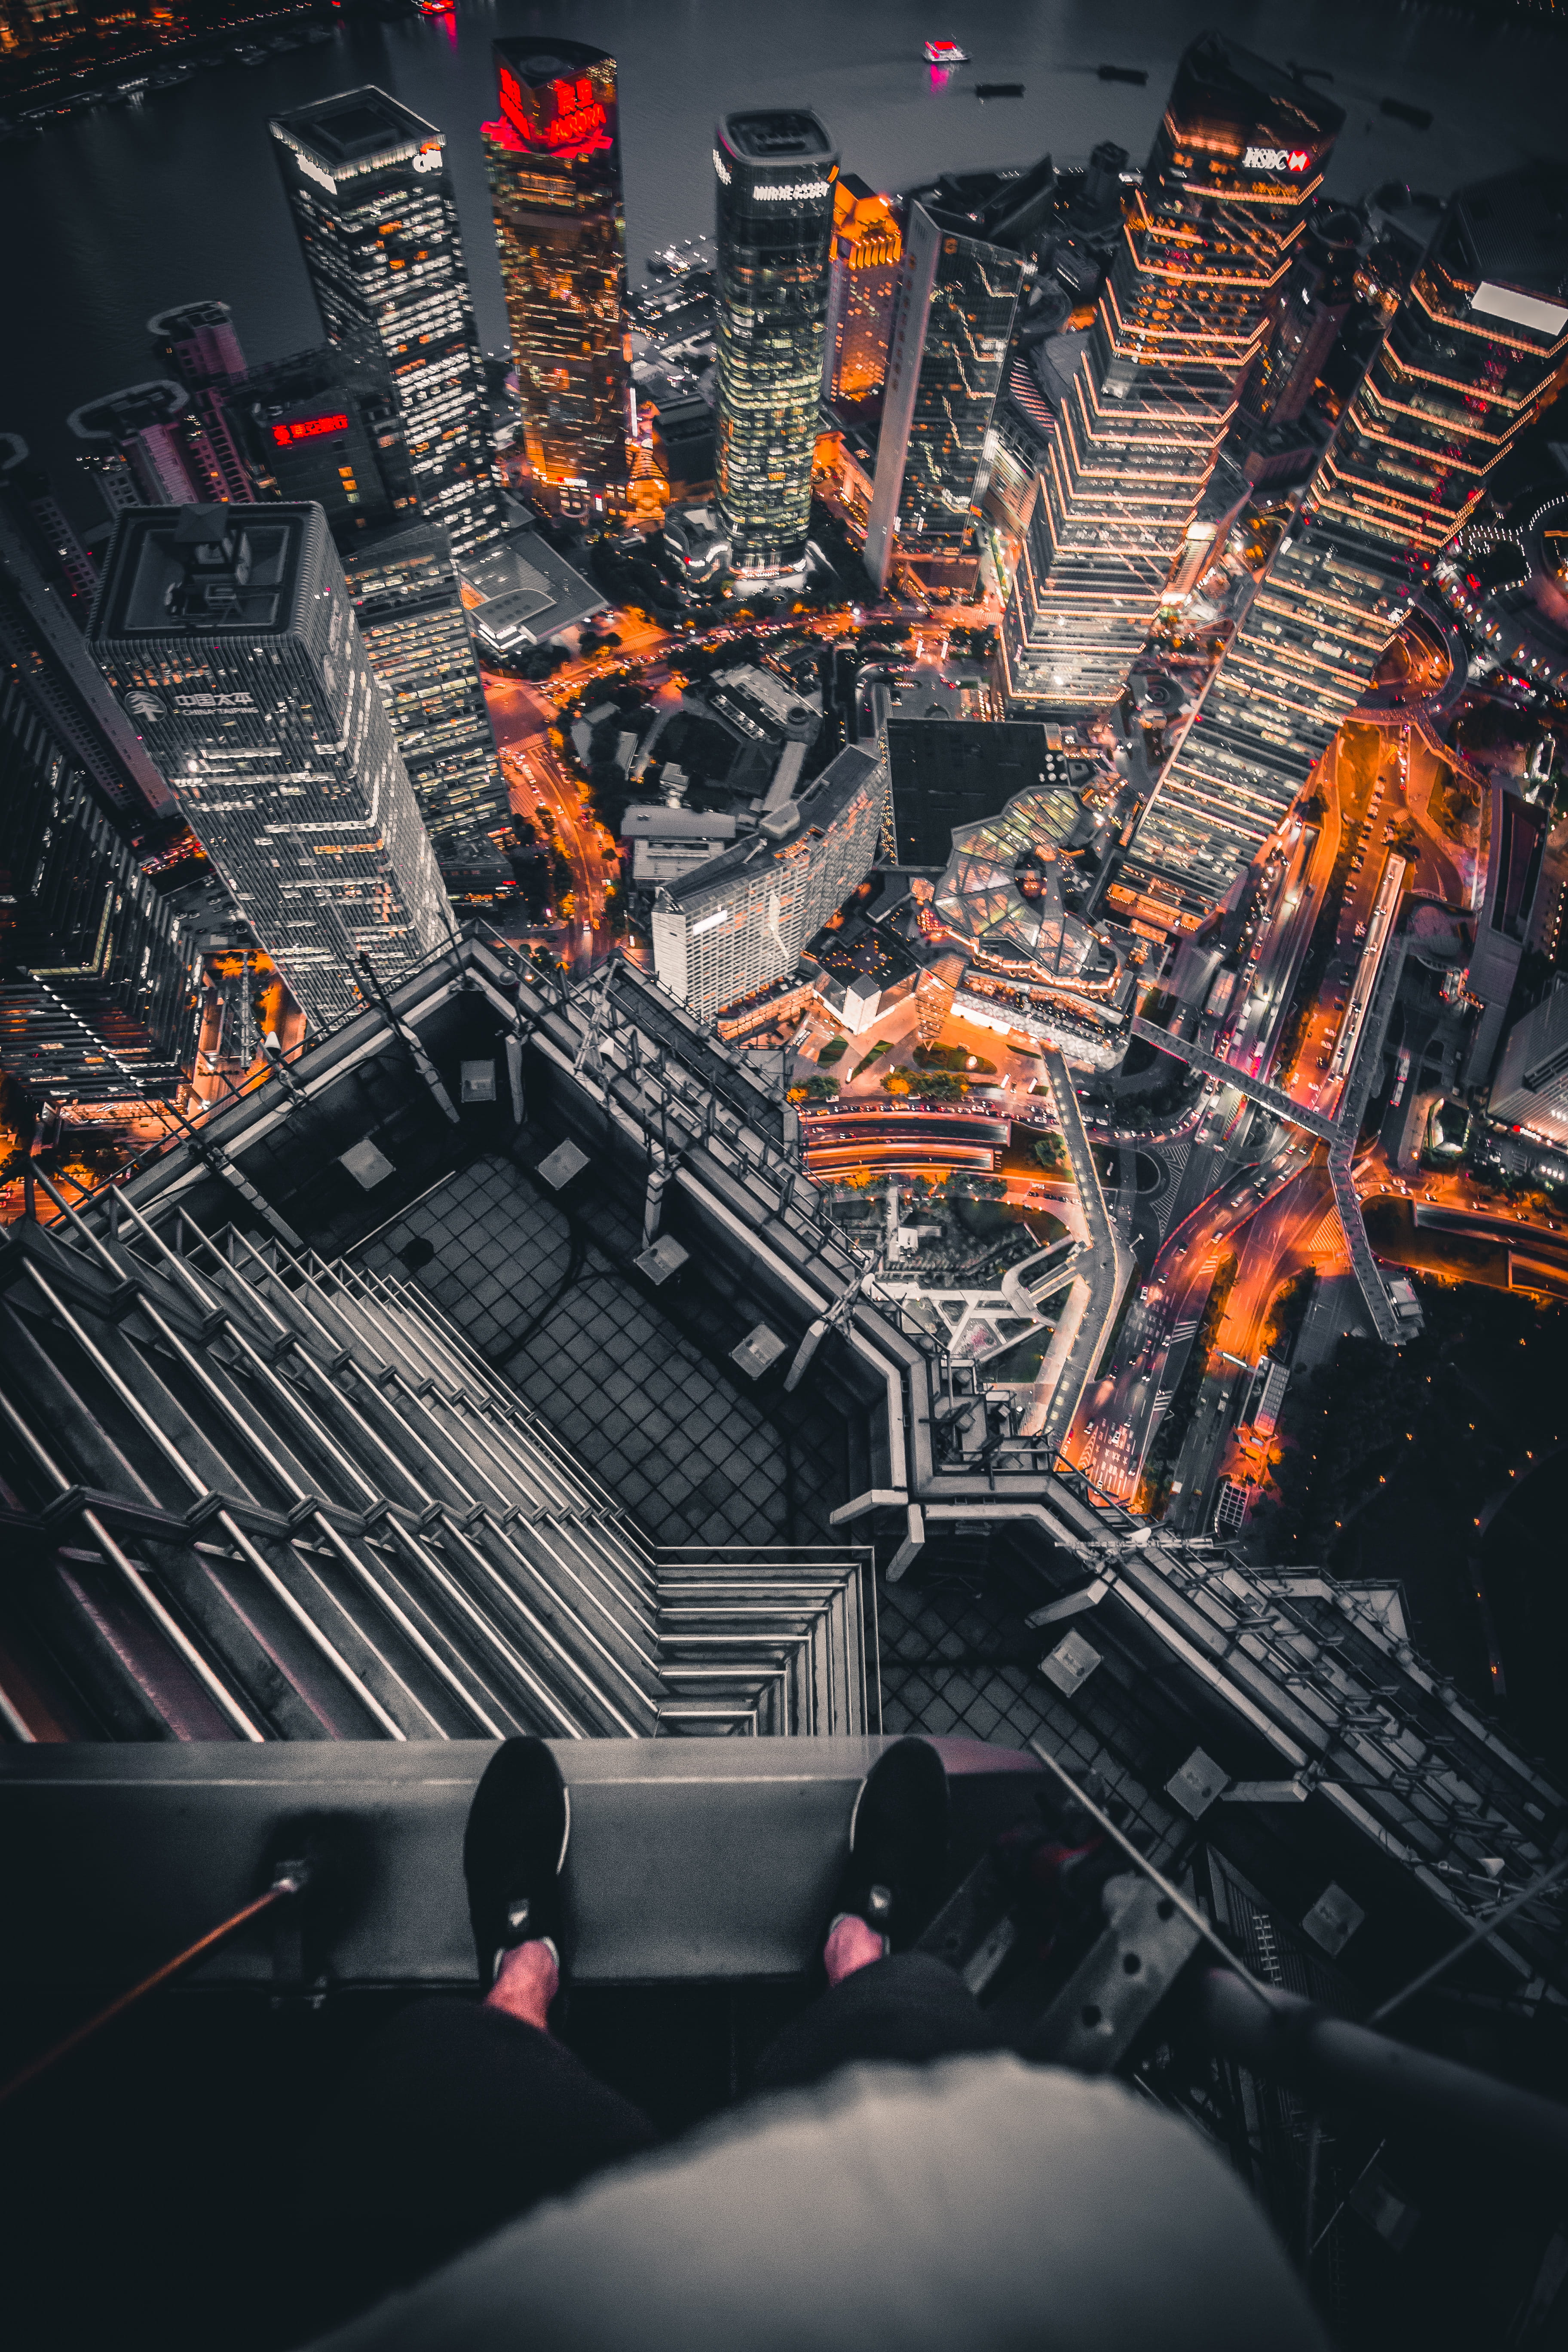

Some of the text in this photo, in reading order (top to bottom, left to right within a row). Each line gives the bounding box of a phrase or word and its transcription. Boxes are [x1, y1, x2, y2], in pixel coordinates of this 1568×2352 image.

[549, 103, 606, 144] AURORA
[1243, 147, 1289, 170] HSBC
[753, 181, 830, 201] MIRAE ASSET
[174, 692, 254, 707] 中国太平
